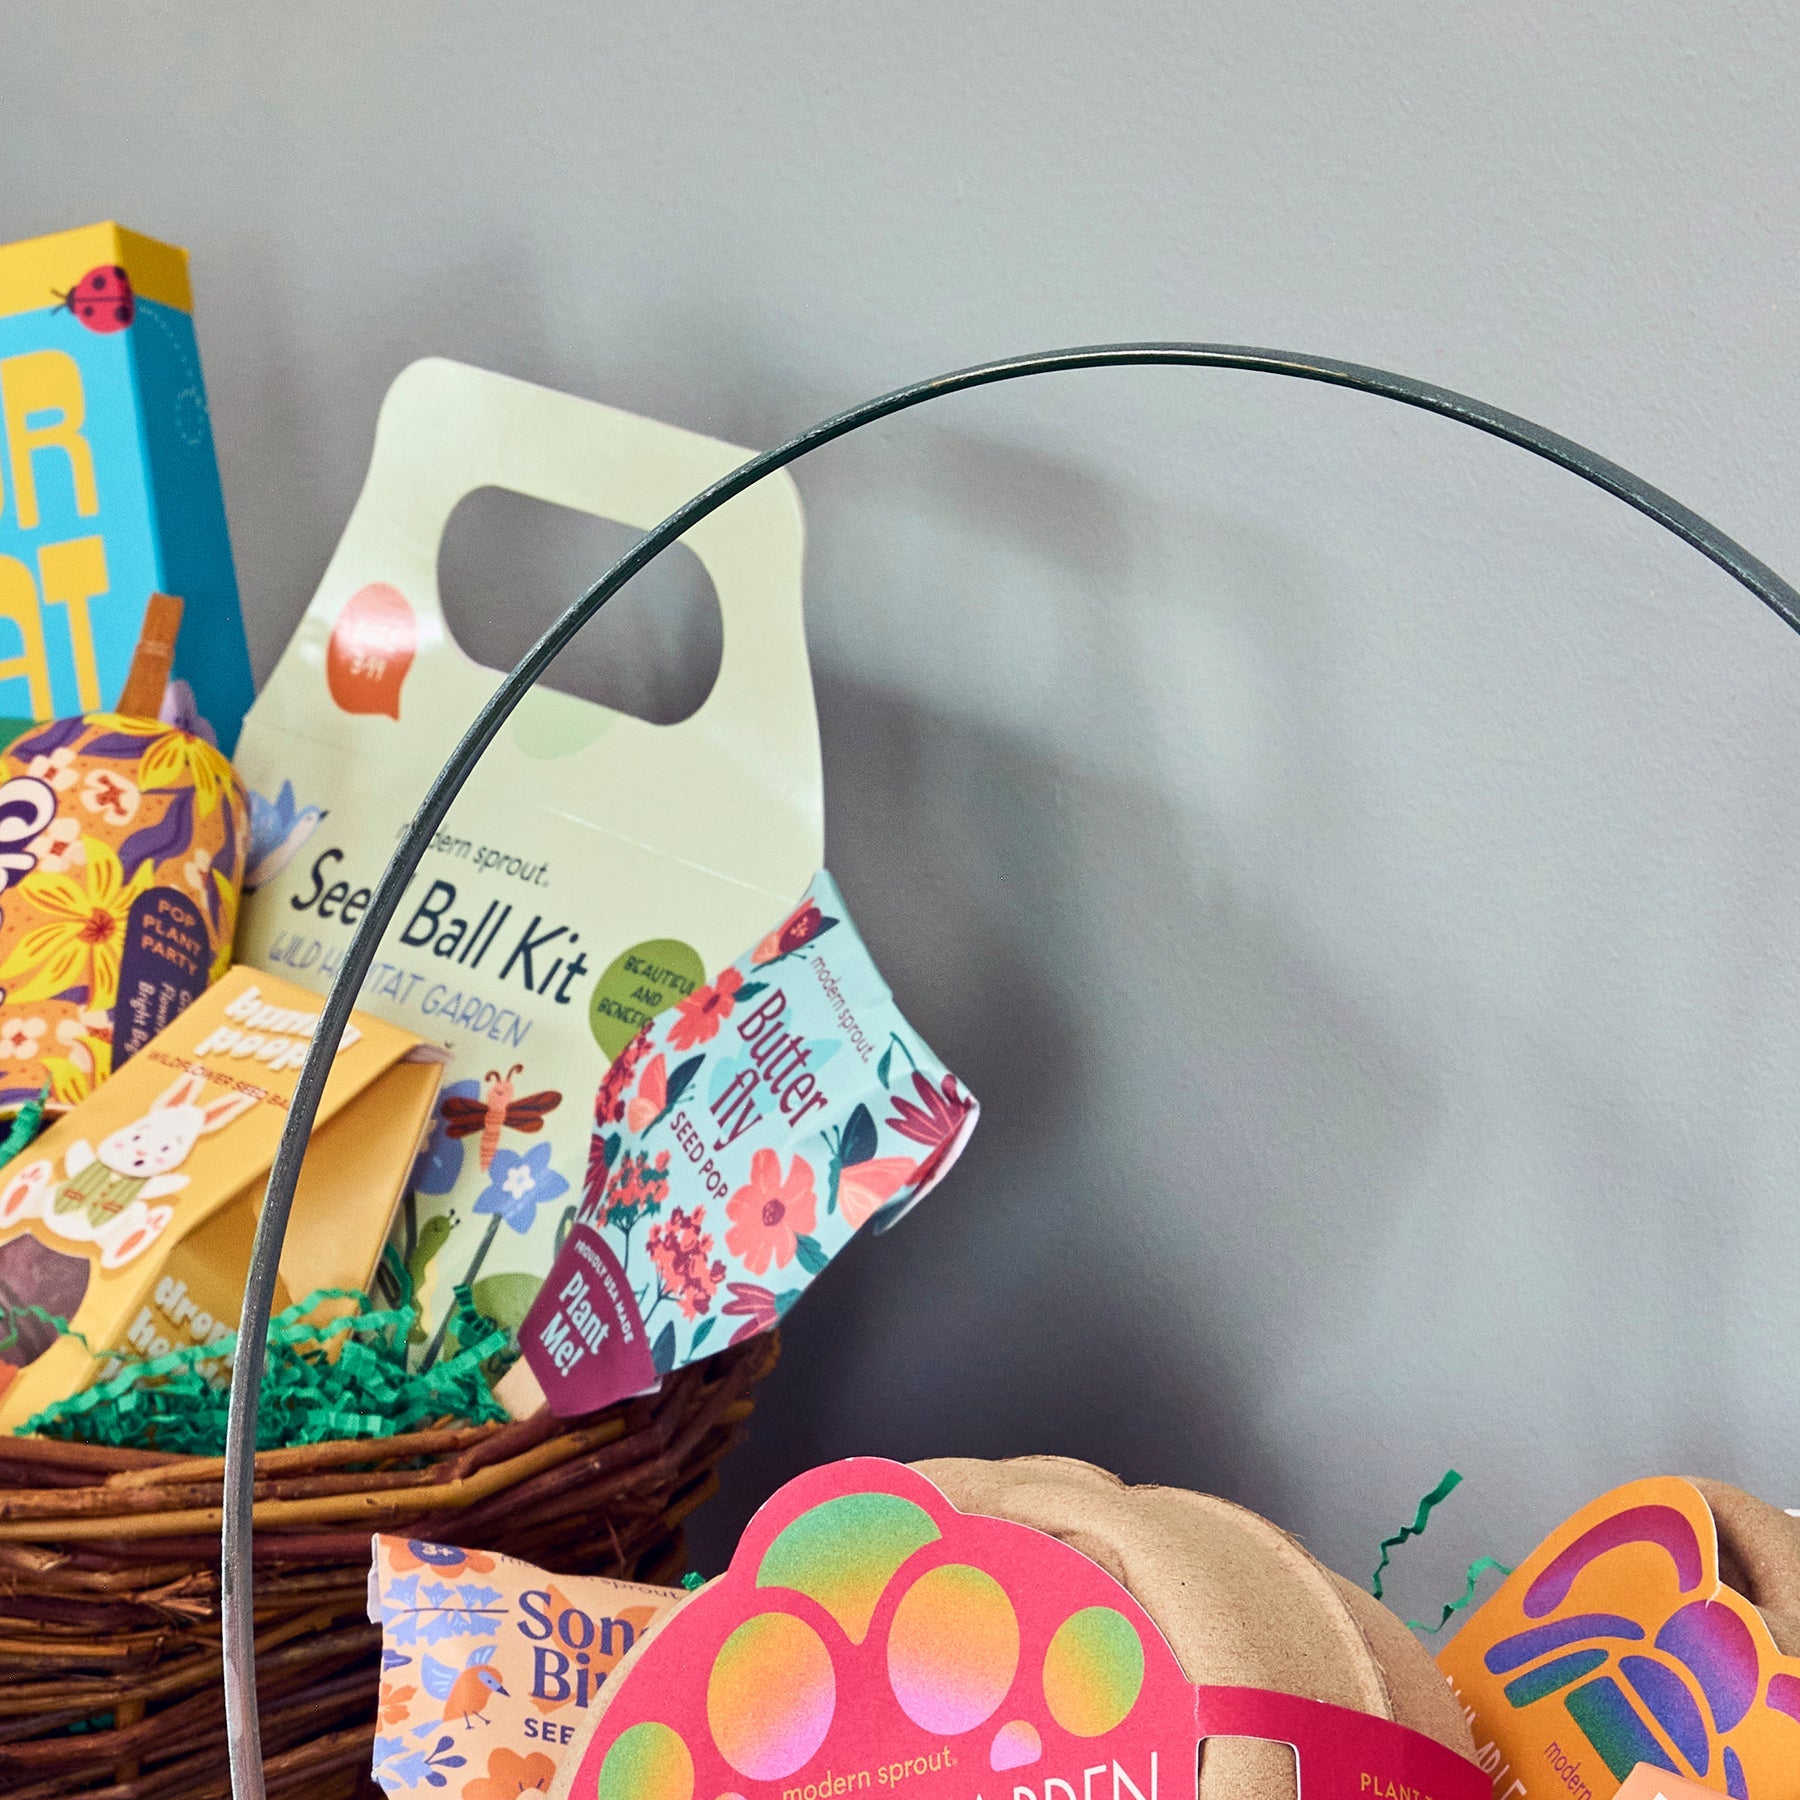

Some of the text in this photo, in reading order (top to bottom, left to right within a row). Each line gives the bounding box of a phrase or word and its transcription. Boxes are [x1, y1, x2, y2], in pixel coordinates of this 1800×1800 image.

[399, 878, 590, 1006] Ball Kit
[808, 955, 845, 1012] modern
[421, 984, 533, 1050] GARDEN
[736, 989, 829, 1128] Butter
[711, 1068, 764, 1153] fly
[669, 1110, 730, 1203] SEED POP
[539, 1311, 585, 1377] Me!
[559, 1270, 610, 1355] Plant
